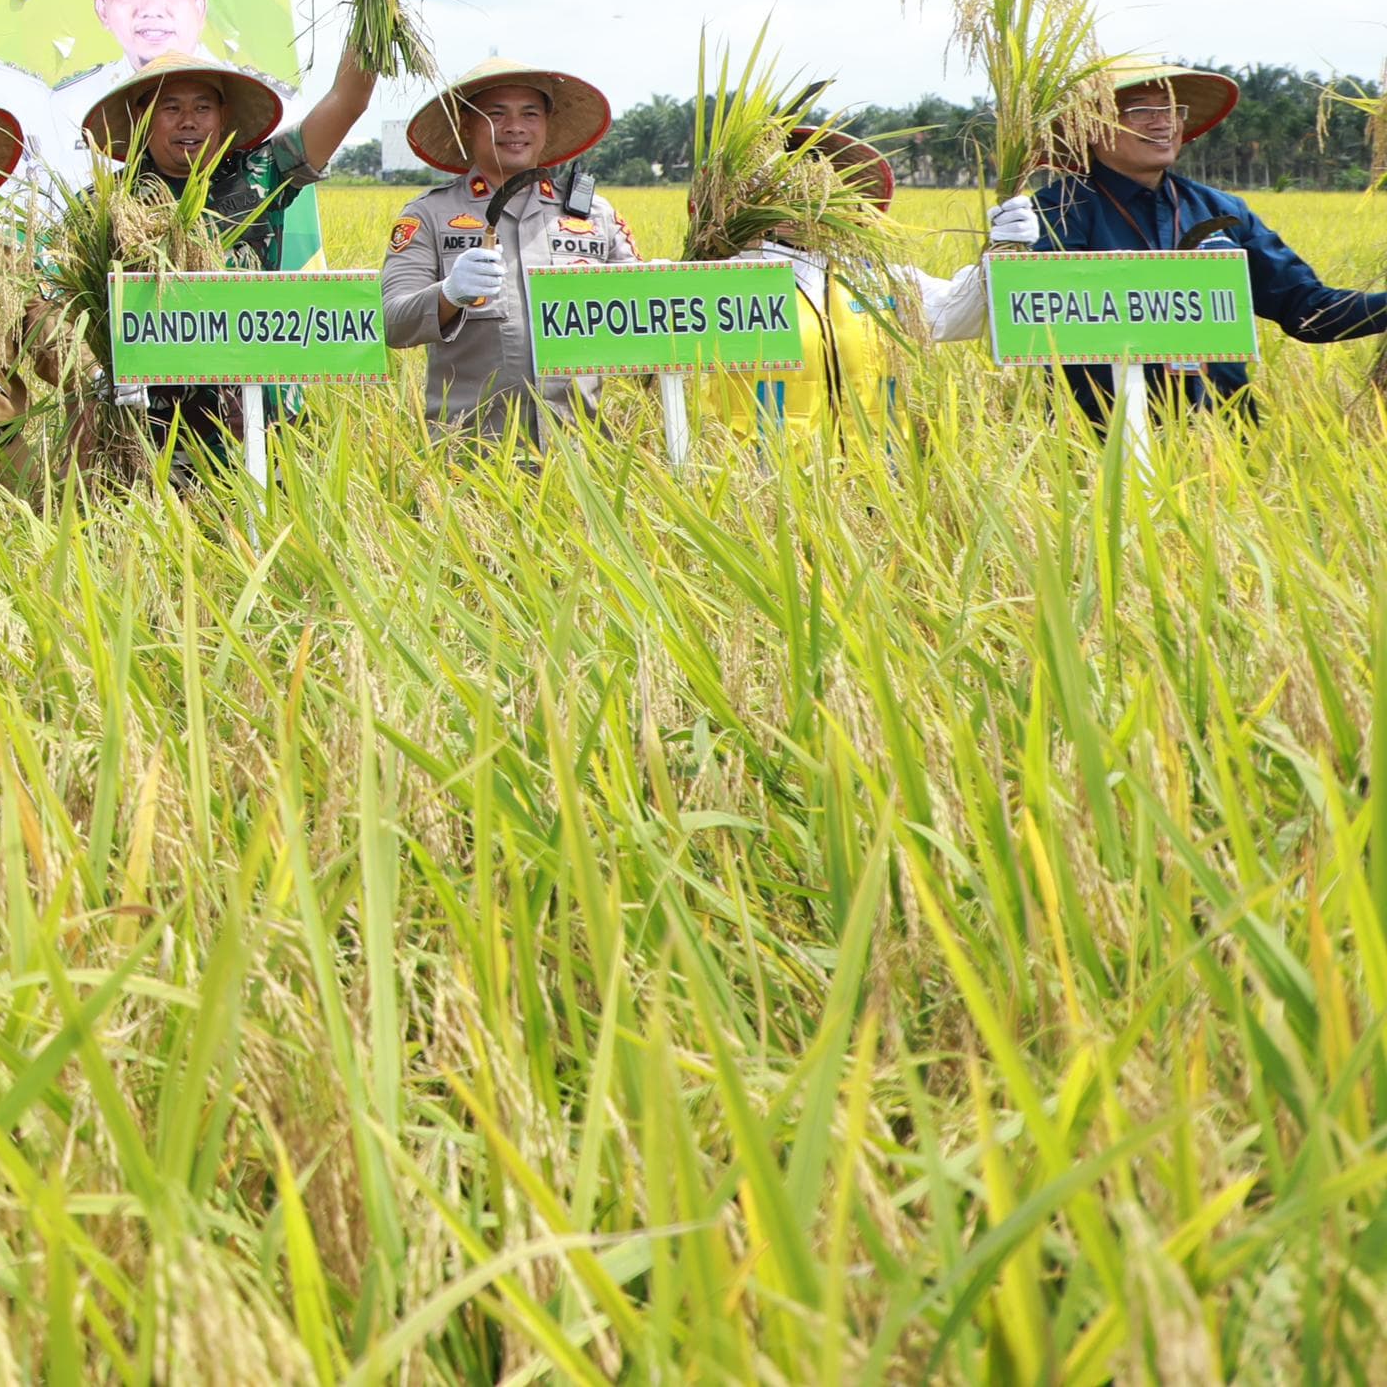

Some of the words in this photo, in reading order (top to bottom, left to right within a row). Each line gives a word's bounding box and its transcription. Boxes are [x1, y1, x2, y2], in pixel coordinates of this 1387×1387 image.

[443, 236, 466, 249] ADE
[552, 239, 605, 256] POLRI
[540, 296, 708, 338] KAPOLRES
[716, 294, 790, 333] SIAK
[1010, 291, 1120, 324] KEPALA
[1127, 290, 1203, 324] BWSS
[1211, 290, 1235, 322] III
[121, 310, 229, 345] DANDIM
[237, 305, 378, 348] 0322/SIAK
